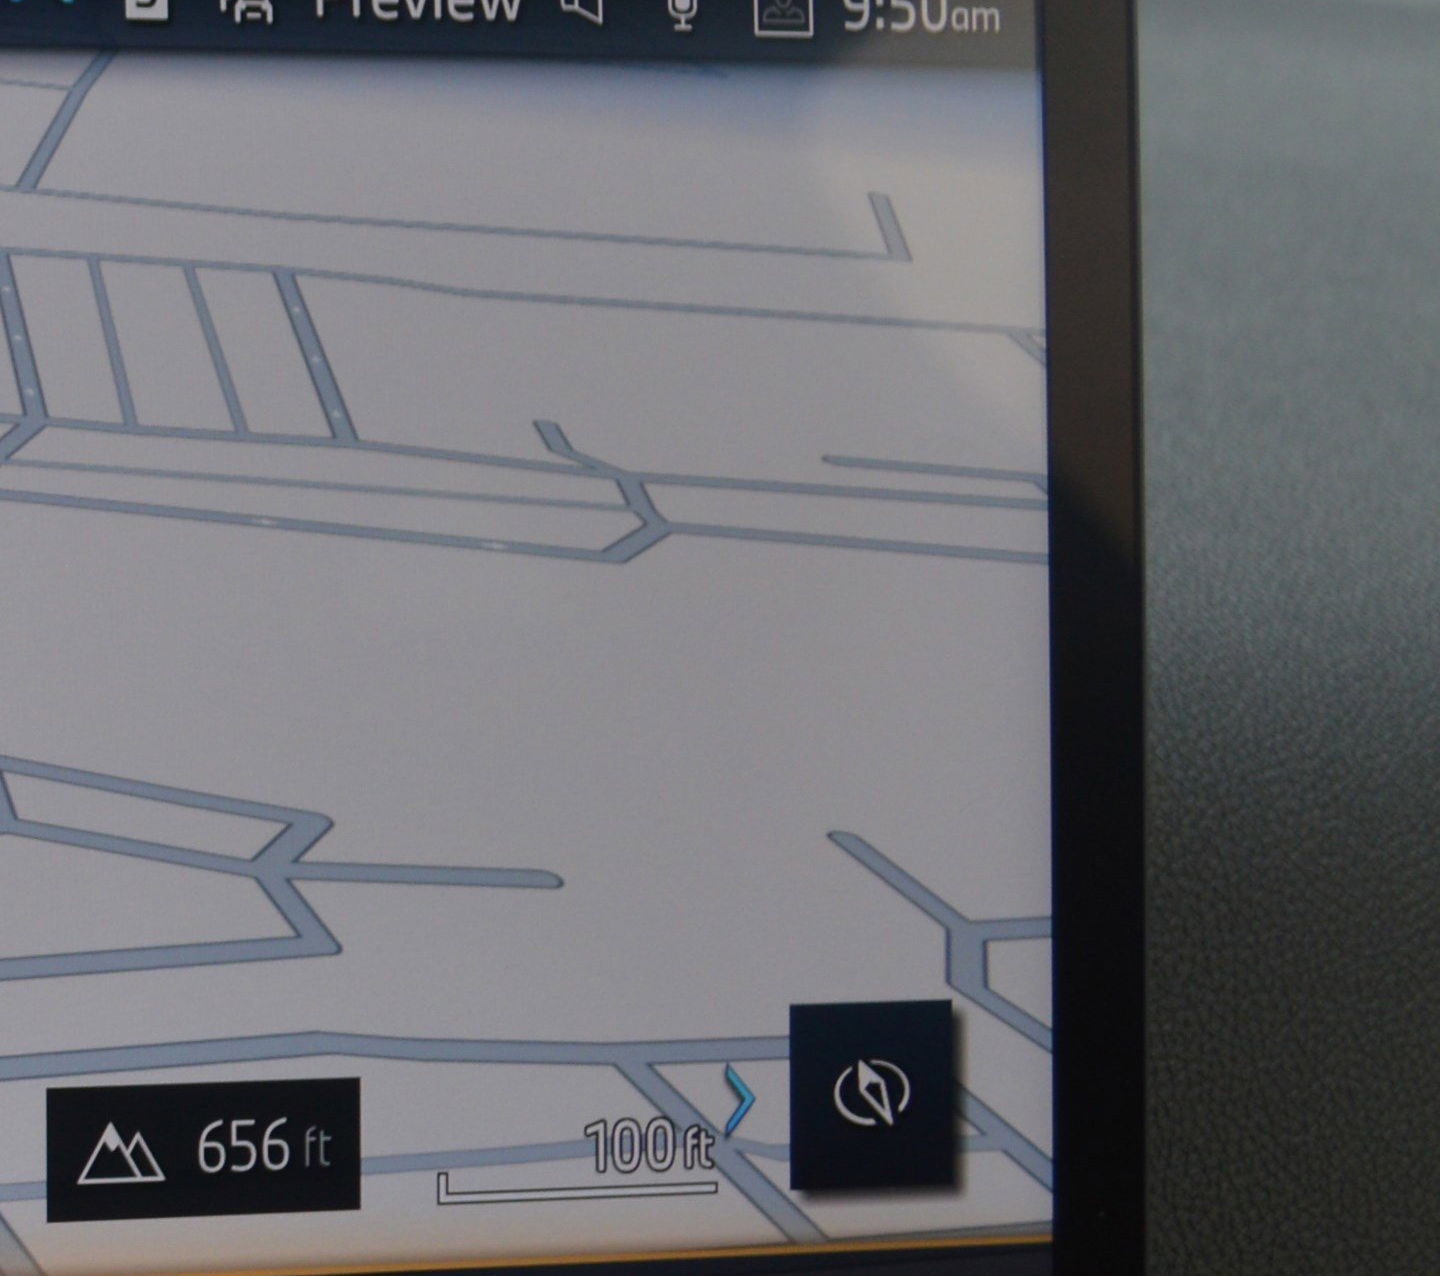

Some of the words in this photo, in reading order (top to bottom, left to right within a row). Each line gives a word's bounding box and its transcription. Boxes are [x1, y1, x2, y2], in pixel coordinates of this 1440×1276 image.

[198, 1117, 290, 1173] 656
[304, 1125, 332, 1167] ft
[584, 1116, 678, 1175] 100
[682, 1123, 716, 1171] ft
